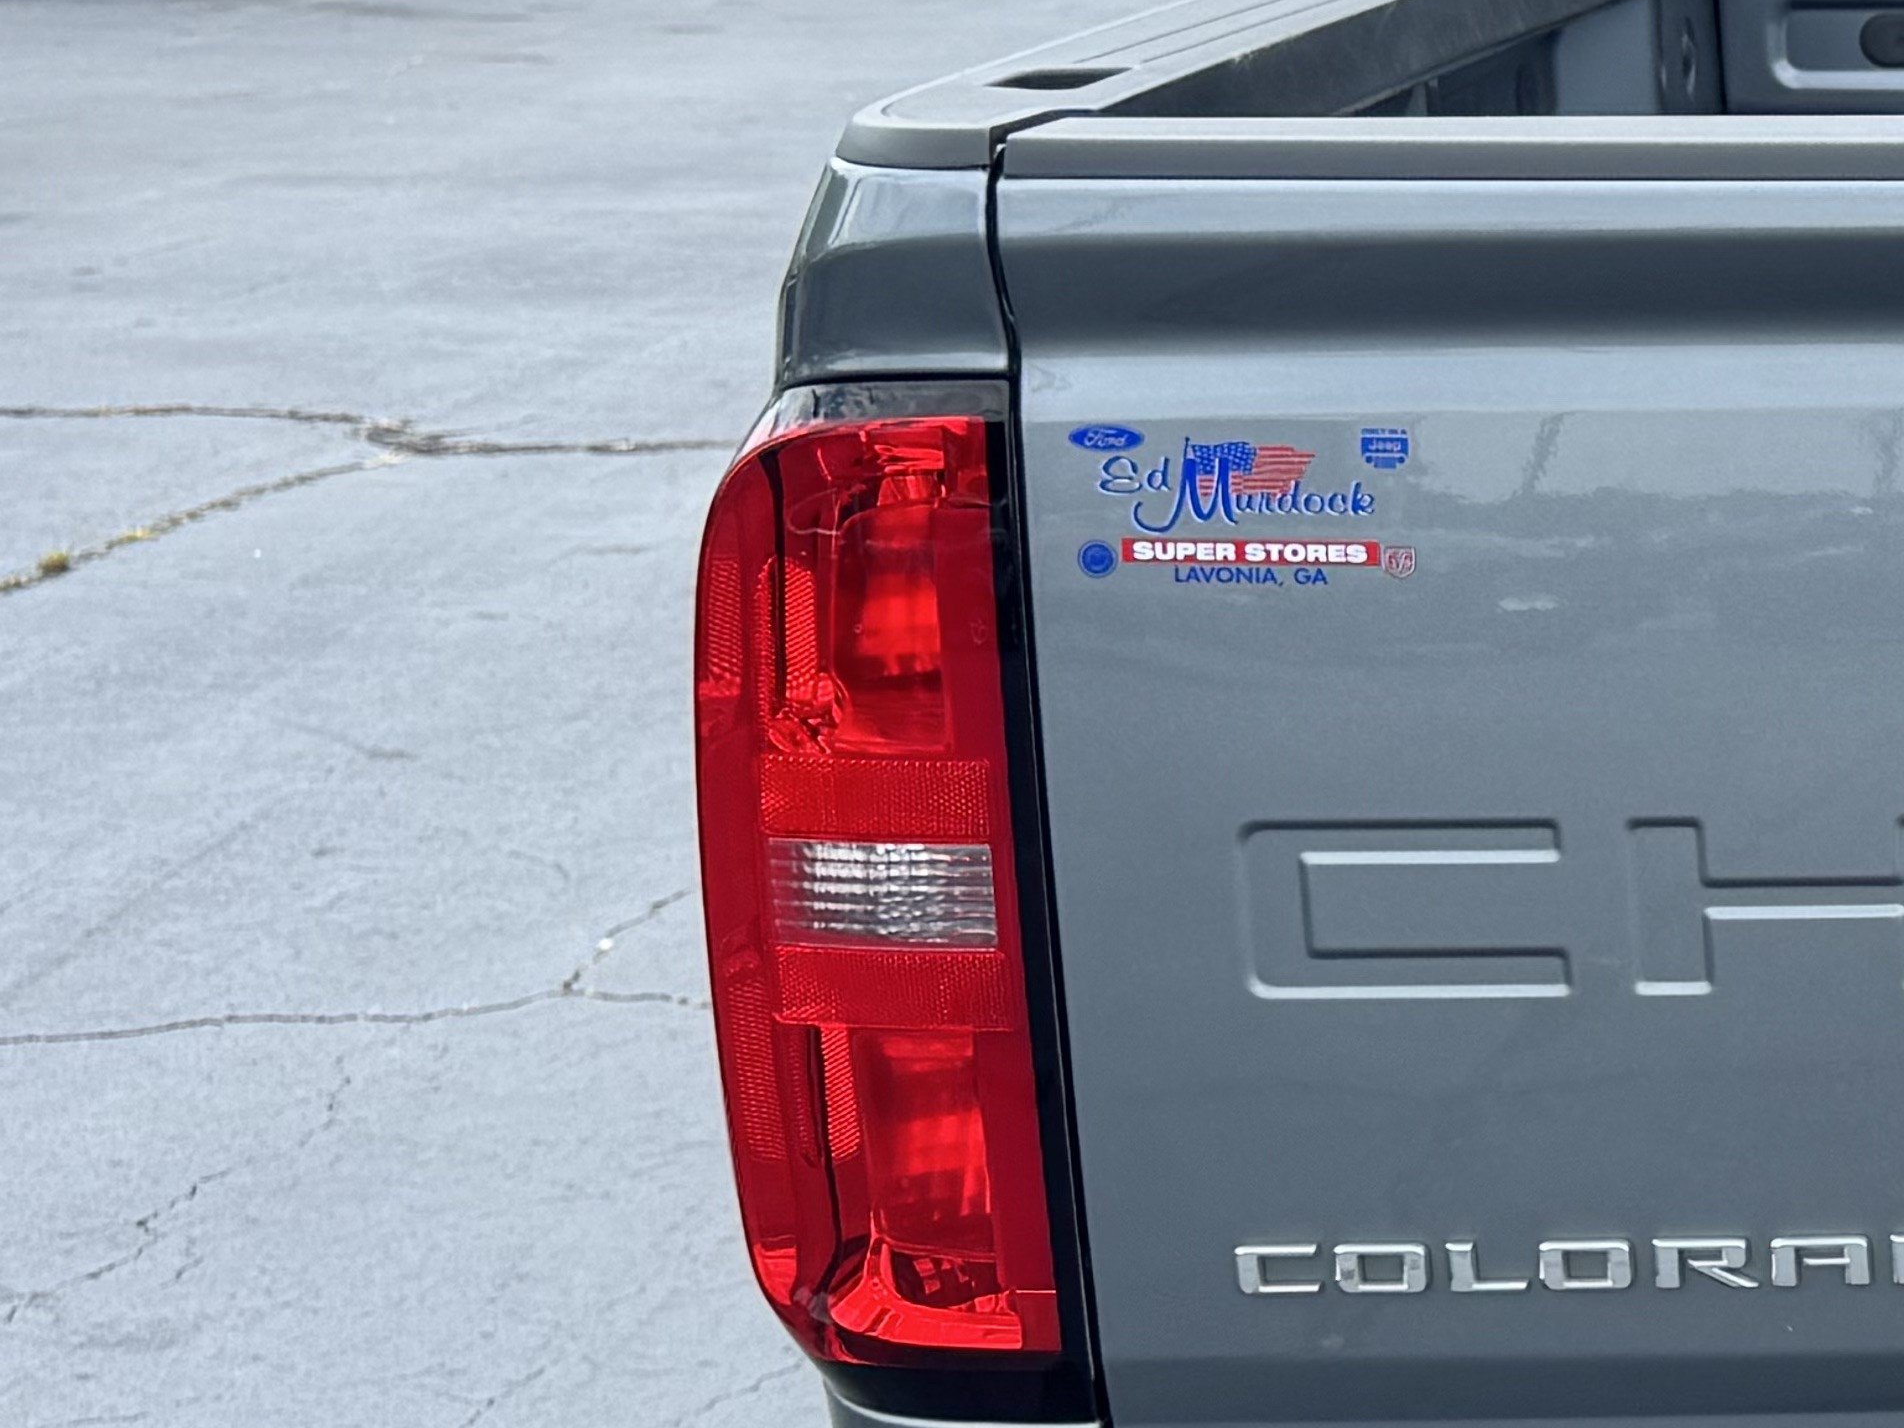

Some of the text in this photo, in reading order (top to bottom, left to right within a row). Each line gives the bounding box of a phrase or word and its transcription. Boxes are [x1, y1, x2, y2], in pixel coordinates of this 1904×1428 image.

[1084, 429, 1129, 447] Ford
[1098, 455, 1376, 534] Ed Murdock
[1133, 540, 1369, 564] SUPER STORES
[1174, 565, 1329, 587] LAVONIA, GA
